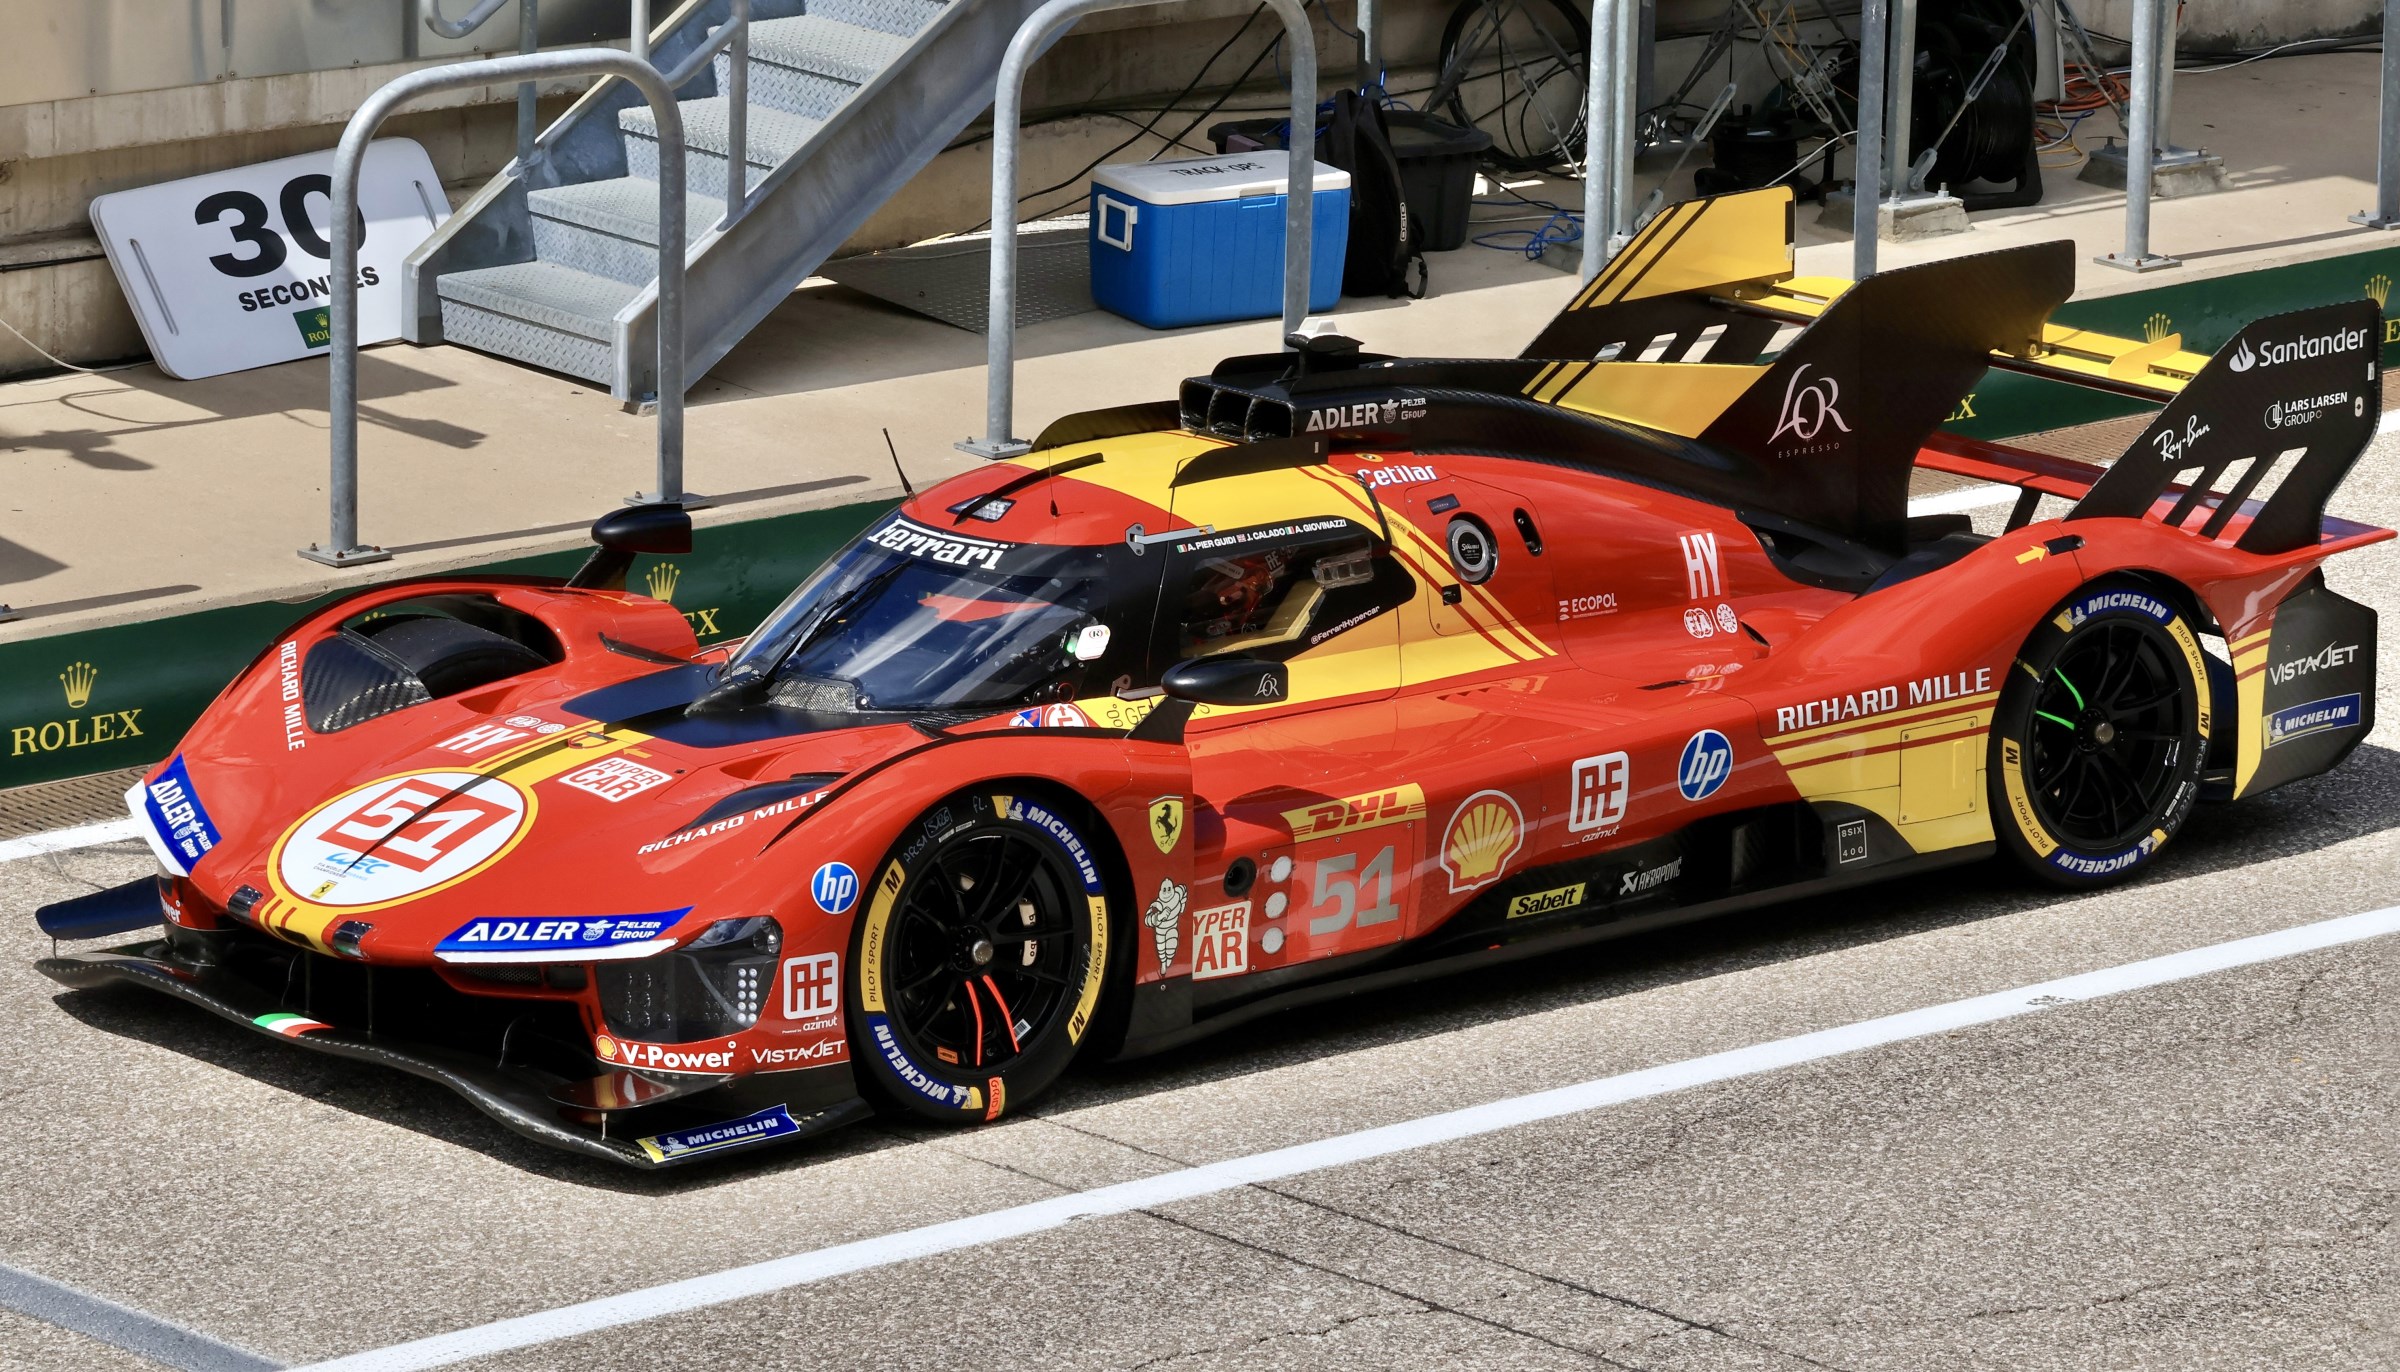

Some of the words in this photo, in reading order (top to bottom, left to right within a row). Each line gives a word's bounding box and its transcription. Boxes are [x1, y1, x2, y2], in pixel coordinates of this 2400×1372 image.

[195, 174, 366, 277] 30
[2259, 327, 2367, 367] Santander
[1401, 410, 1427, 420] GROUP
[2285, 397, 2309, 413] LARS
[2311, 392, 2348, 409] LARSEN
[1305, 403, 1379, 432] ADLER
[2284, 412, 2315, 428] GROUP
[1778, 442, 1839, 458] ESPRESSO
[1357, 465, 1439, 489] Cetilar
[1253, 527, 1286, 540] CALADO
[1295, 526, 1303, 534] A.
[1303, 519, 1347, 532] GIOVINAZZI
[867, 517, 1009, 570] Ferrari
[1187, 543, 1196, 552] A.
[1197, 540, 1214, 550] PIER
[1214, 536, 1236, 547] GUIDI
[1680, 533, 1720, 600] HY
[1572, 593, 1617, 612] ECOPOL
[2088, 592, 2167, 619] MICHELIN
[1310, 605, 1380, 645] @FerrariHypercar
[2175, 624, 2192, 647] PILOT
[2191, 650, 2205, 681] SPORT
[2270, 641, 2359, 685] VISTAJET
[281, 640, 299, 701] RICHARD
[1776, 685, 1898, 732] RICHARD
[1908, 667, 1991, 705] MILLE
[11, 708, 144, 757] ROLEX
[284, 703, 305, 751] MILLE
[2284, 705, 2350, 732] MICHELIN
[435, 724, 530, 754] HY
[604, 759, 663, 785] HYPER
[1684, 731, 1727, 799] hp
[569, 768, 642, 799] CAR
[149, 778, 195, 829] ADLER
[1308, 791, 1409, 833] DHL
[2015, 795, 2034, 824] SPORT
[335, 787, 486, 861] 51
[637, 815, 745, 854] RICHARD
[1581, 825, 1620, 843] azimut
[1841, 826, 1862, 837] 8SIX
[2029, 821, 2048, 849] PILOT
[181, 838, 199, 858] GROUP
[195, 830, 213, 852] PELZER
[1026, 806, 1098, 883] MICHELIN
[1842, 846, 1864, 857] 400
[2056, 848, 2138, 875] MICHELIN
[819, 864, 853, 913] hp
[1310, 845, 1399, 936] 51
[1515, 887, 1576, 915] Sabelt
[458, 921, 580, 942] ADLER
[611, 930, 656, 939] GROUP
[616, 920, 661, 930] PELZER
[1096, 905, 1104, 937] PILOT
[868, 923, 879, 965] SPORT
[1094, 941, 1103, 983] SPORT
[869, 968, 877, 1002] PILOT
[802, 1015, 838, 1032] azimut
[620, 1043, 734, 1068] V-Power
[751, 1037, 846, 1064] VISTAJET
[874, 1024, 950, 1101] MICHELIN
[687, 1117, 779, 1146] MICHELIN
